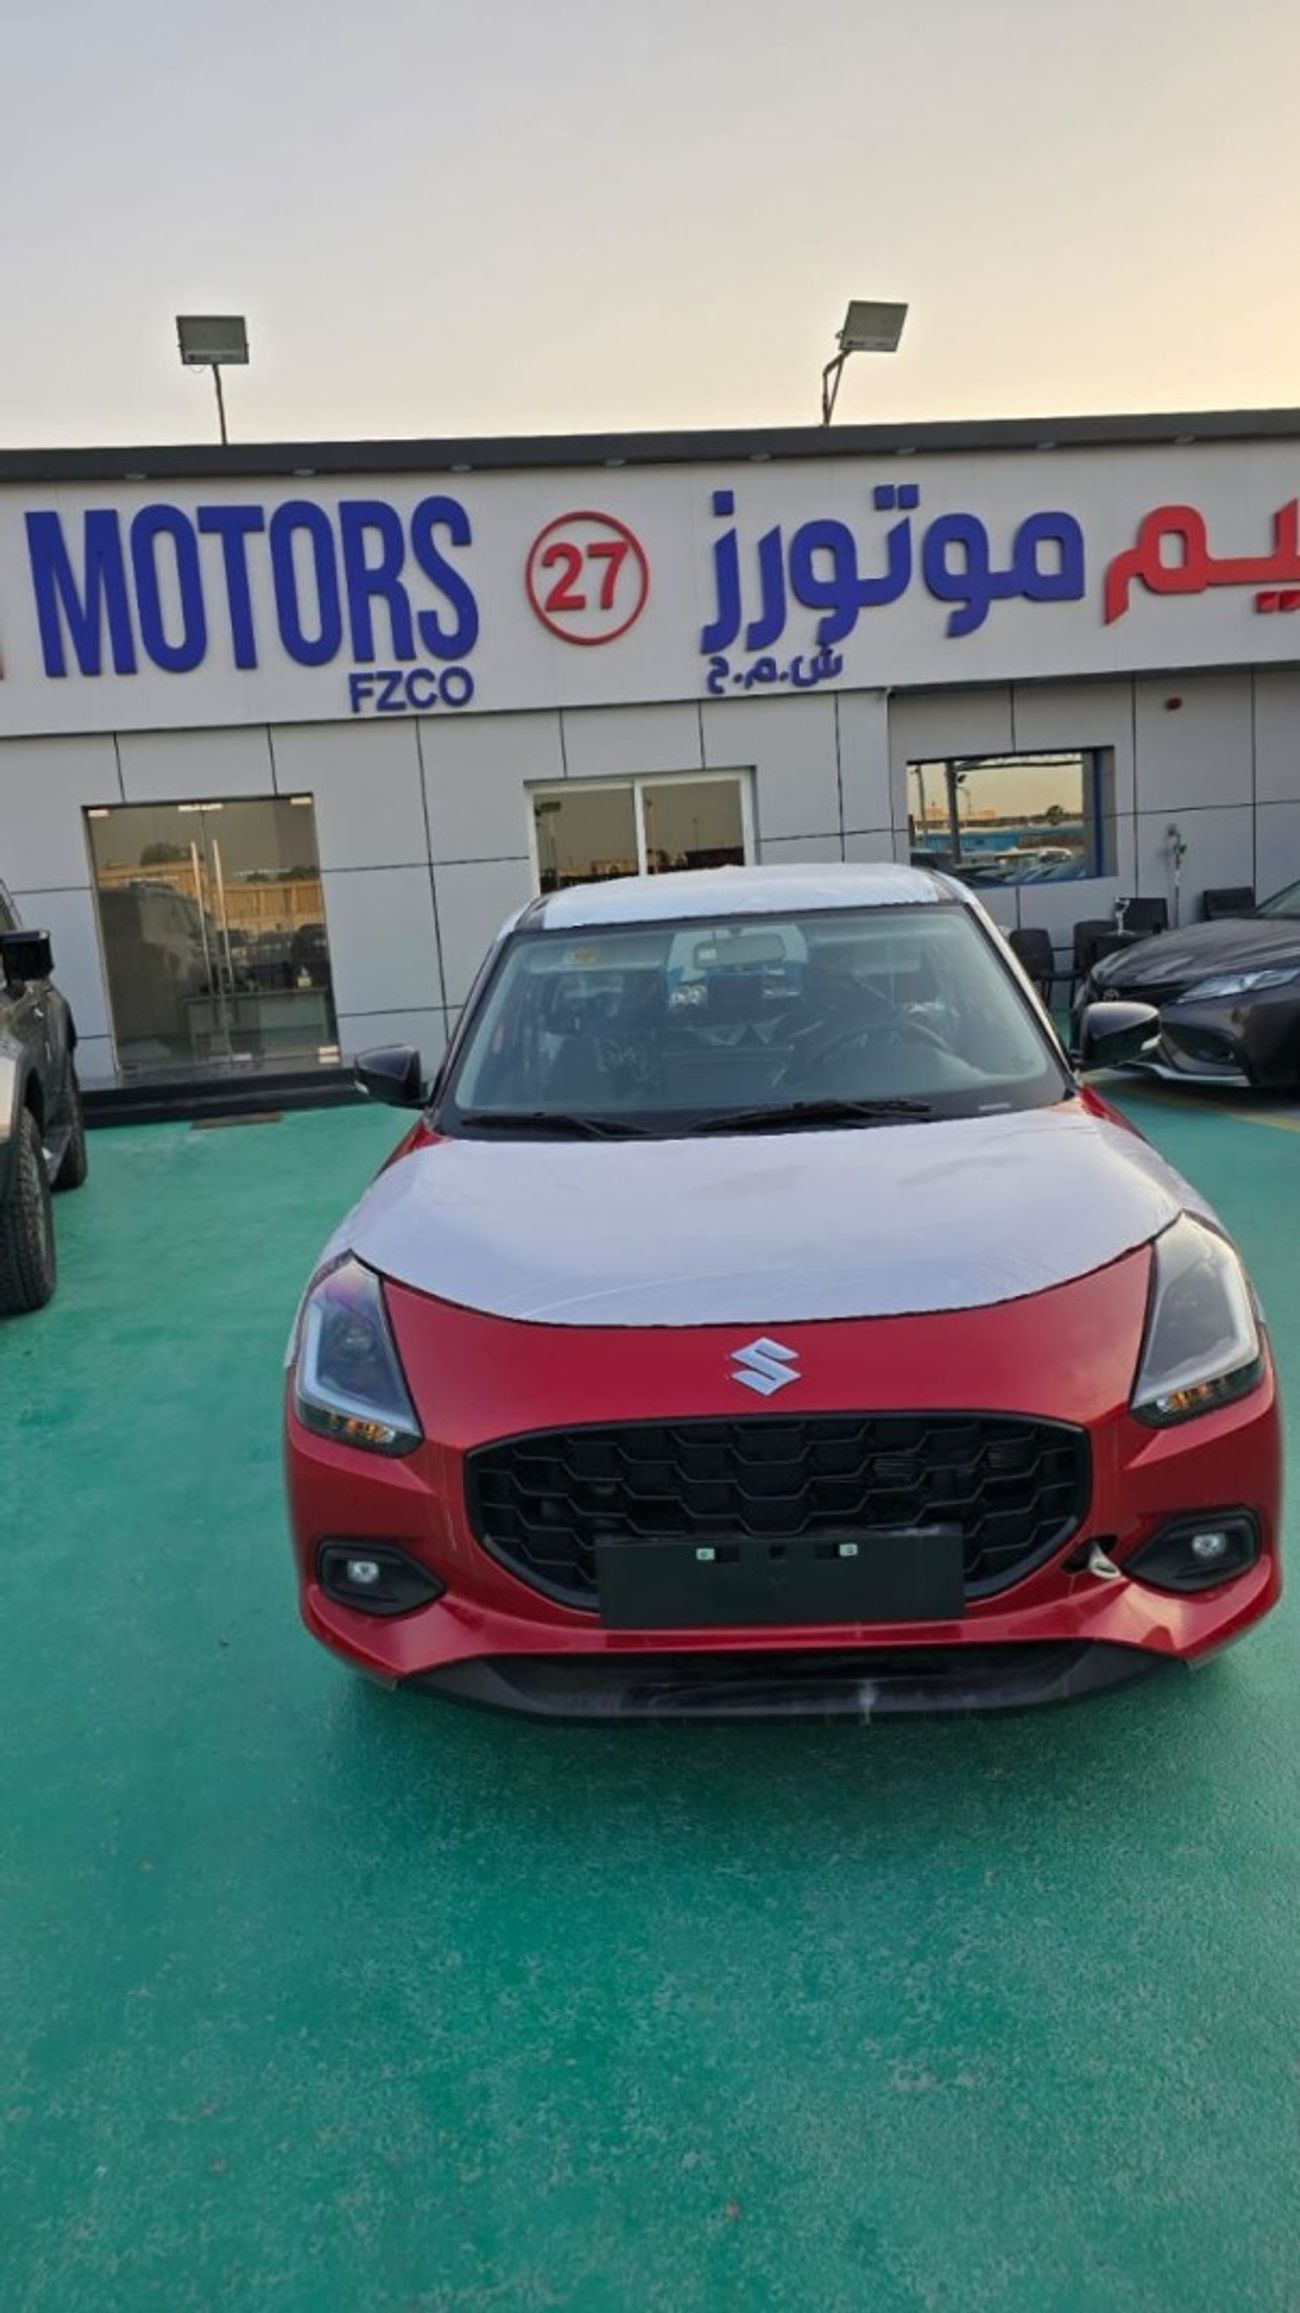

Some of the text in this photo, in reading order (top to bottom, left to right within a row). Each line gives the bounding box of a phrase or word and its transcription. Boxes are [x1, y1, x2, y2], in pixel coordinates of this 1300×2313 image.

[25, 494, 480, 677] MOTORS
[541, 541, 630, 613] 27
[699, 484, 1086, 656] موتورز
[347, 665, 475, 713] FZCO
